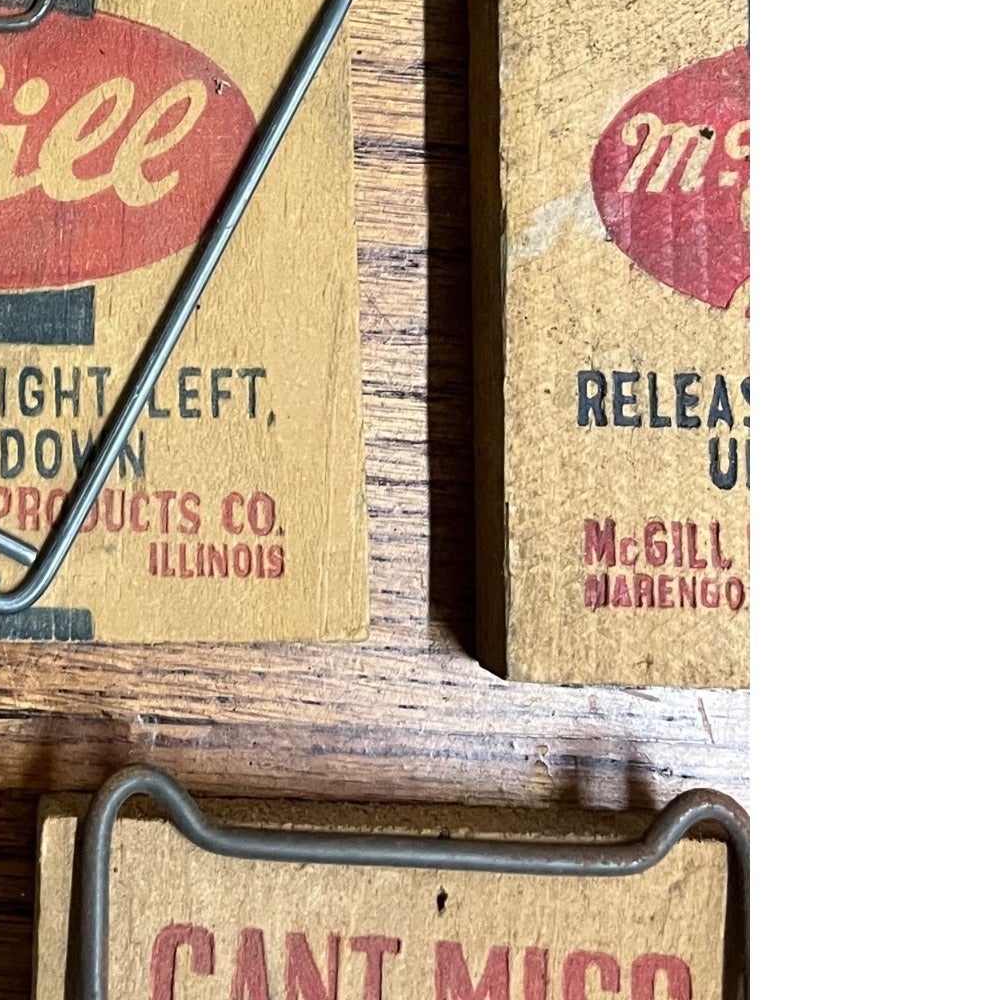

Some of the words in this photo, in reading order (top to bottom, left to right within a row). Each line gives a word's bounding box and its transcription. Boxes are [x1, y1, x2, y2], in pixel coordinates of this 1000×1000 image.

[577, 369, 750, 429] RELEA
[220, 489, 286, 537] CO.
[148, 541, 286, 579] ILLINOIS
[583, 517, 732, 571] McGILL
[583, 573, 747, 611] MARENGO
